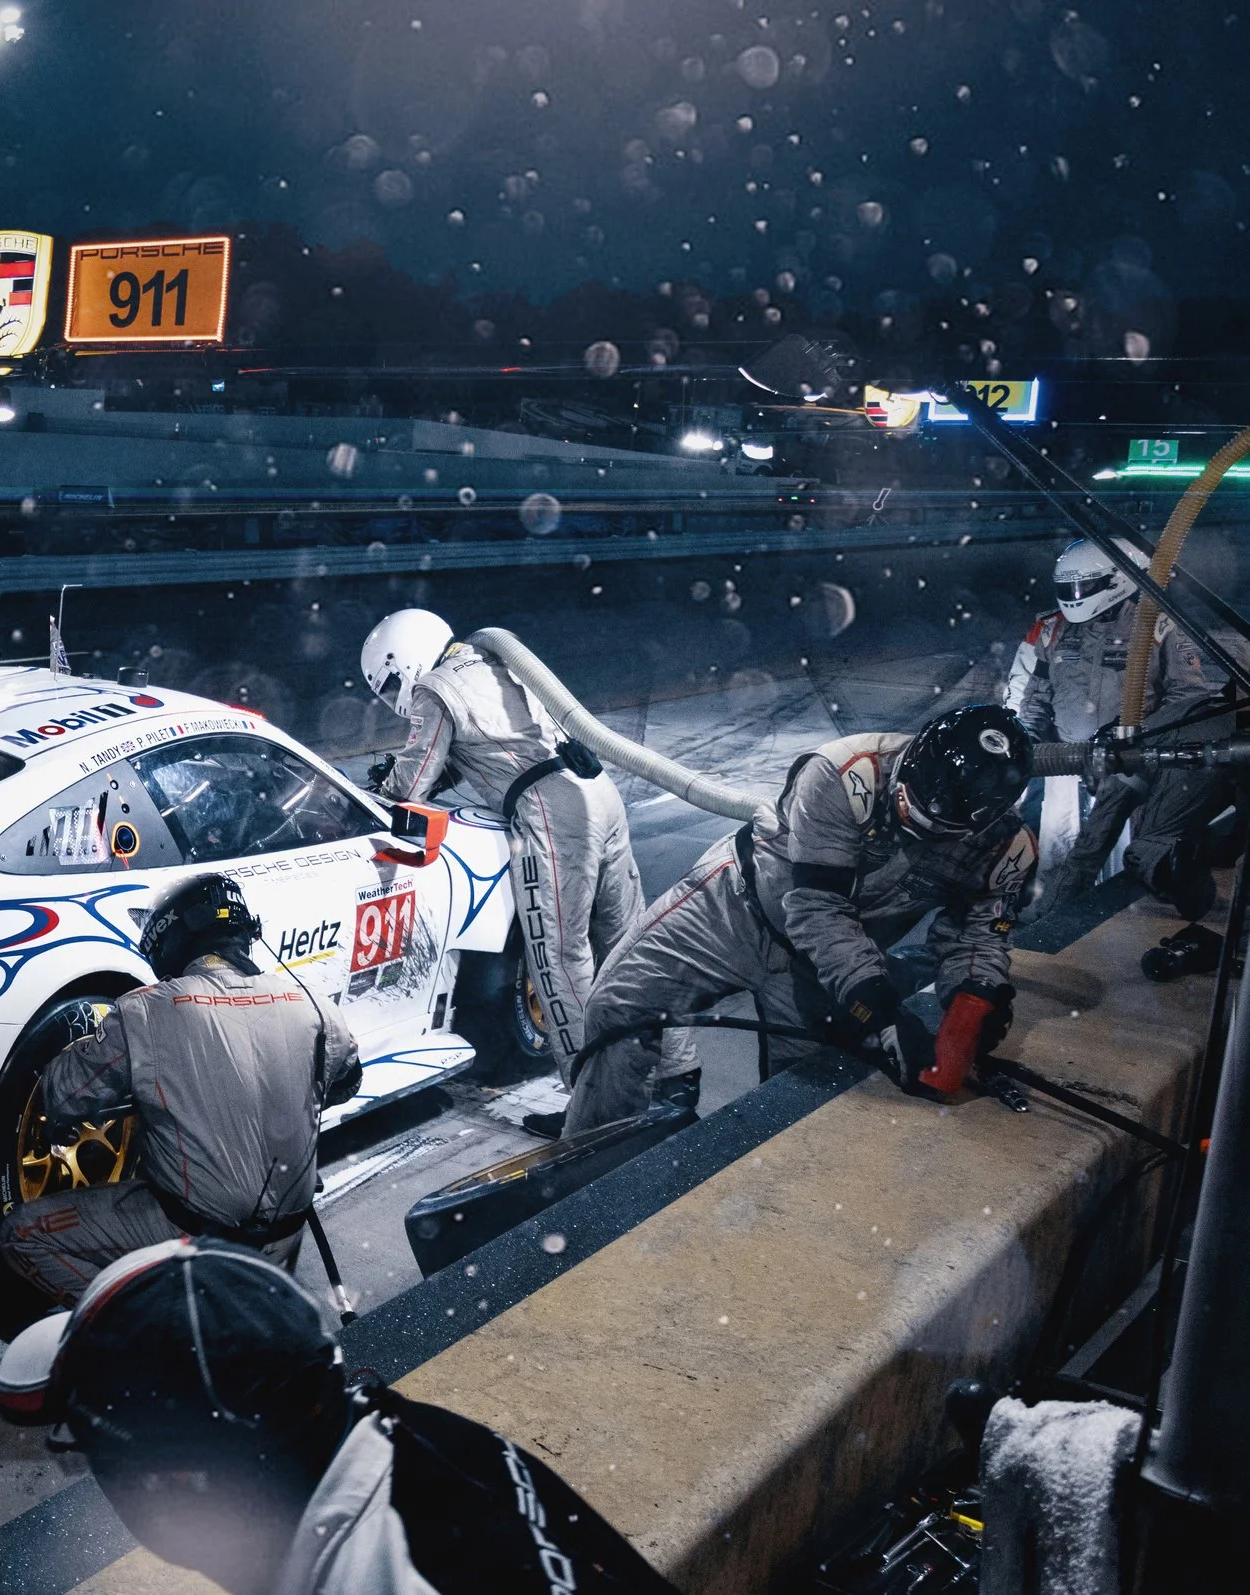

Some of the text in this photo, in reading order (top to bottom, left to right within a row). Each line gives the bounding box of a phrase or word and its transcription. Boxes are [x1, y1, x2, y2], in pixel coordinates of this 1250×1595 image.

[80, 242, 224, 261] PORSCHE
[109, 268, 189, 328] 911
[965, 384, 1011, 412] 12
[1137, 439, 1171, 456] 15
[0, 709, 108, 749] Mobil
[78, 762, 93, 775] N.
[91, 745, 122, 767] TANDY
[136, 737, 147, 749] P.
[146, 727, 172, 745] PILET
[217, 849, 362, 879] RSCHE DESIGN
[226, 890, 246, 906] uv
[358, 878, 414, 901] WeatherTech
[144, 908, 180, 953] uvex
[278, 919, 342, 962] Hertz
[357, 894, 412, 967] 911
[522, 856, 579, 1056] PORSCHE
[174, 991, 304, 1007] PORSCHE
